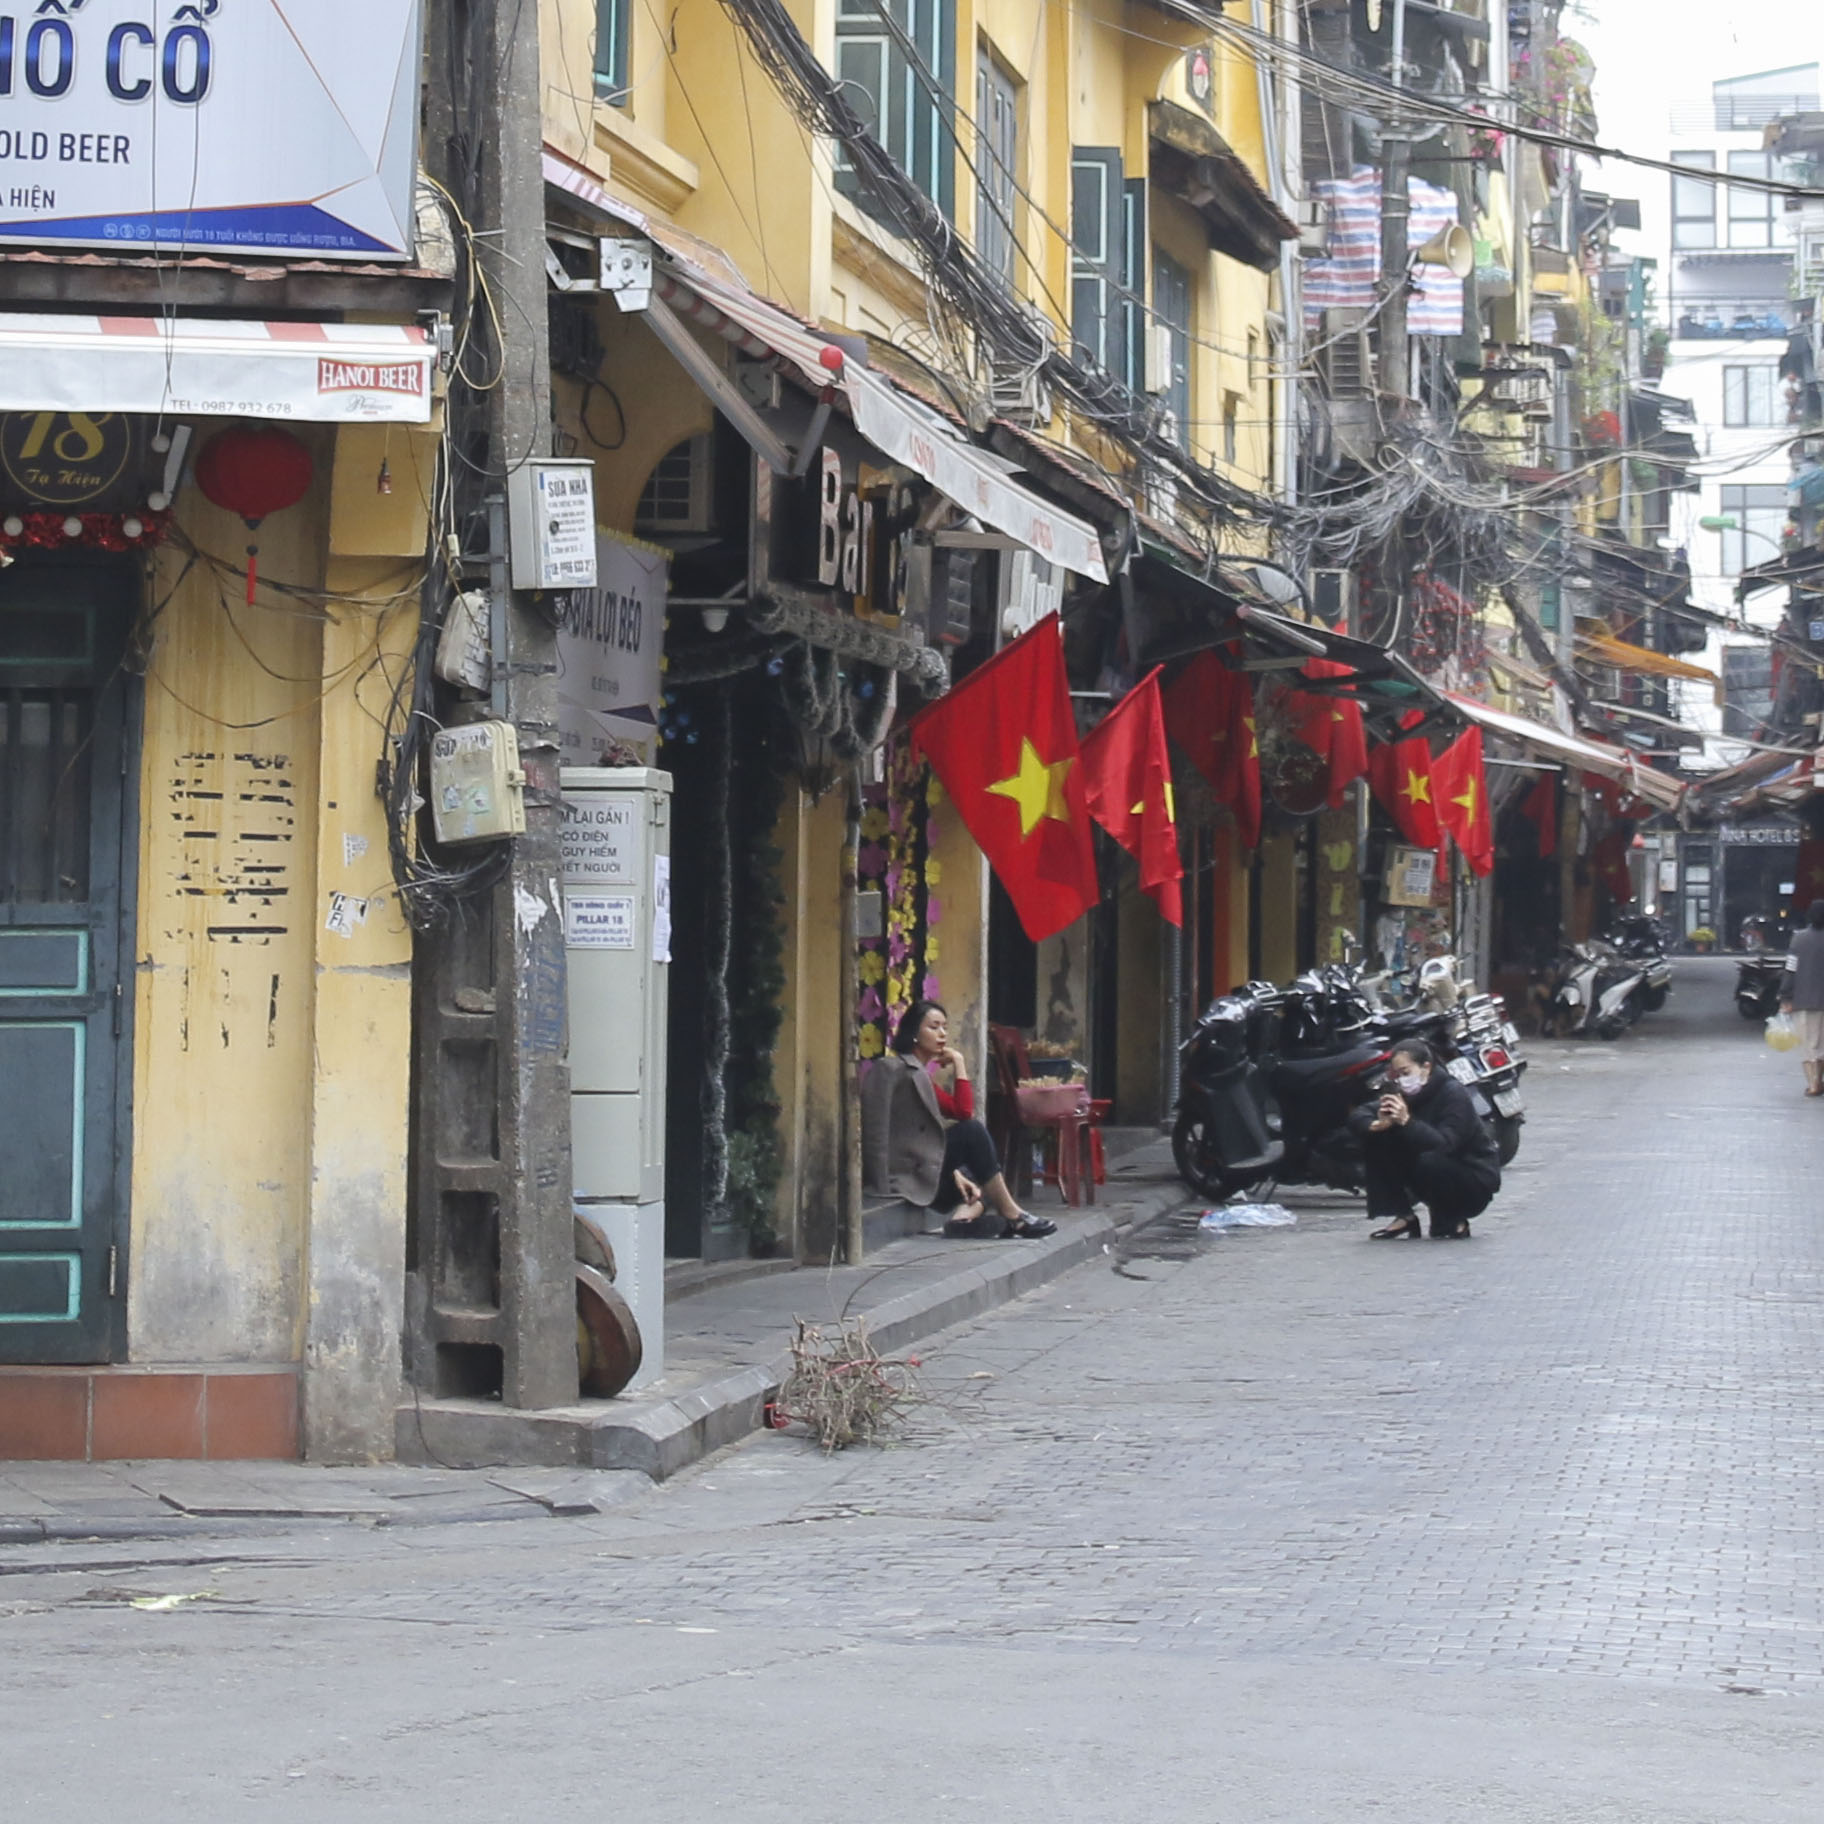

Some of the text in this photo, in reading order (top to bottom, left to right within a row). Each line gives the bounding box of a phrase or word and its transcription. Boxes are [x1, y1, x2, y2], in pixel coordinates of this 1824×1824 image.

[58, 131, 131, 166] BEER
[9, 183, 56, 212] HIỆN
[321, 359, 422, 393] HANOI BEER
[201, 400, 235, 414] 0987
[237, 401, 263, 414] 932
[266, 401, 292, 415] 678
[19, 412, 113, 463] 18
[819, 446, 873, 597] Bar
[619, 586, 642, 654] BÉO
